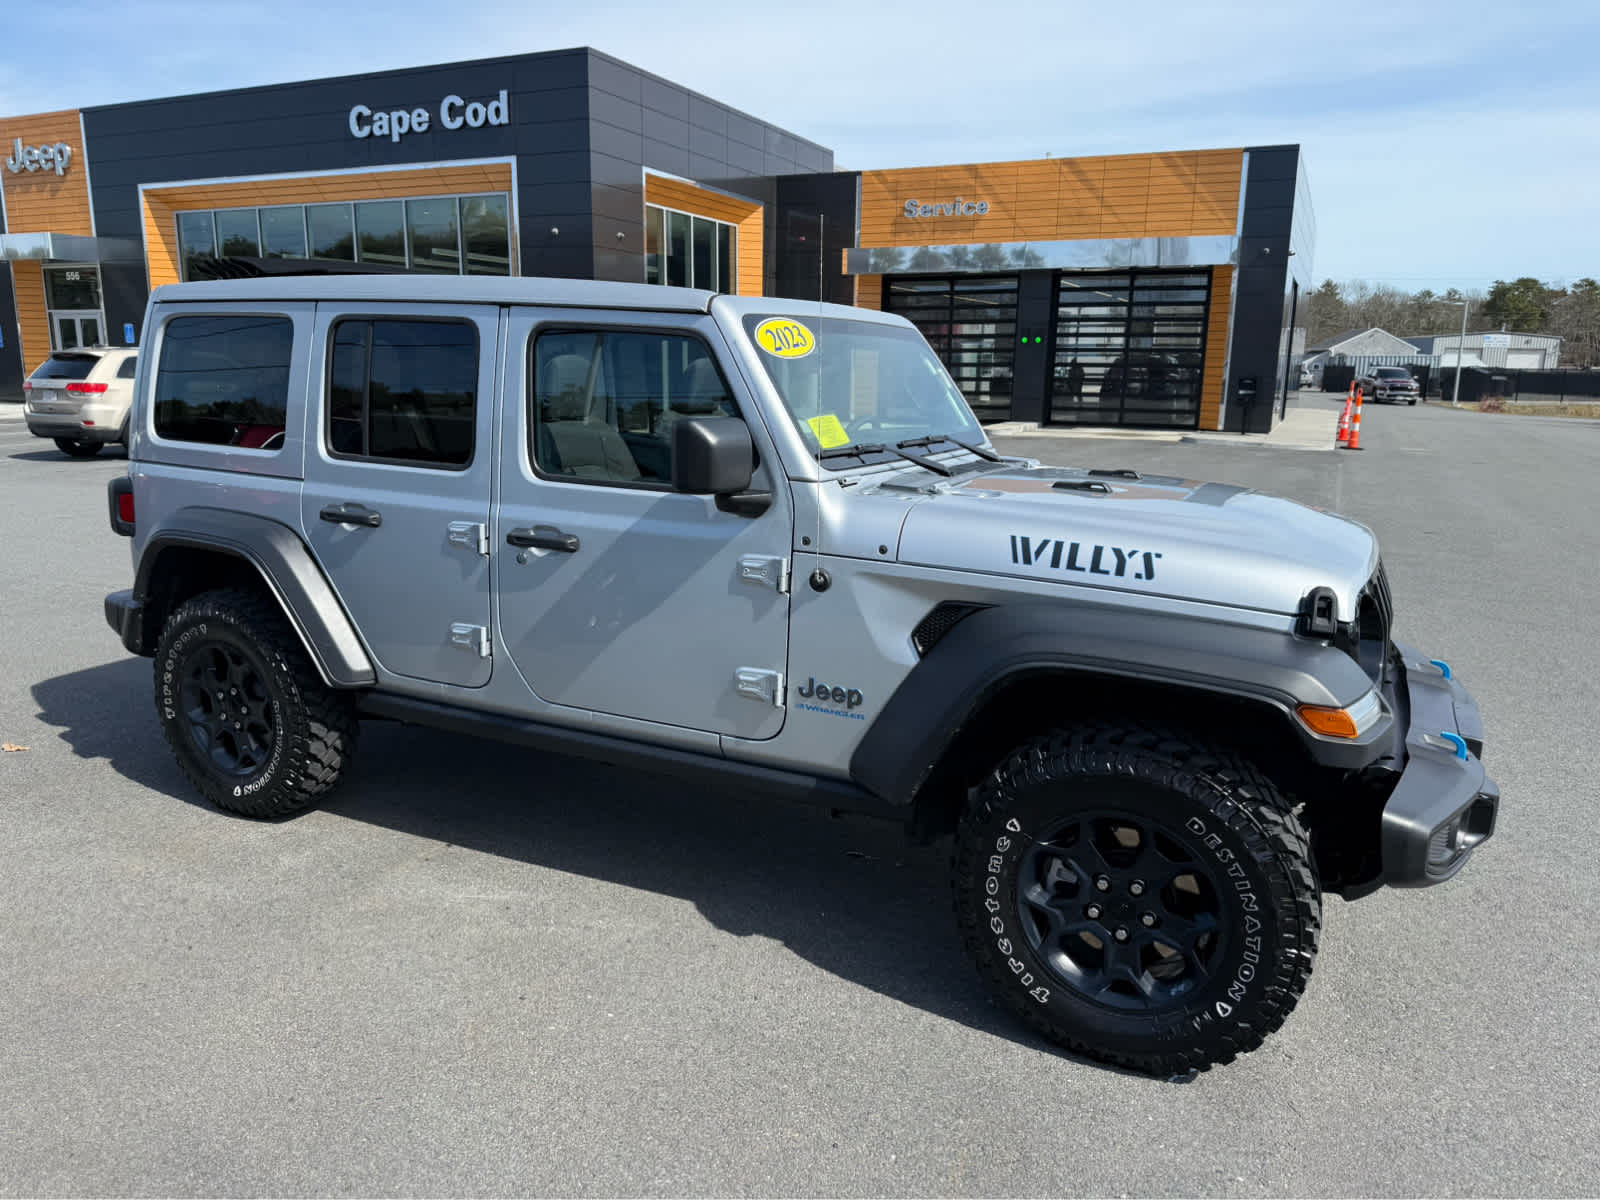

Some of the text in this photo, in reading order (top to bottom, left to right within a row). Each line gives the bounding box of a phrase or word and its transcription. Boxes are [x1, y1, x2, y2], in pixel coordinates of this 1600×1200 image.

[349, 89, 510, 142] Cape Cod
[6, 137, 73, 176] Jeep
[904, 197, 990, 218] Service
[765, 325, 808, 352] 2023
[1010, 535, 1162, 581] WILLYS
[798, 677, 863, 709] Jeep
[1185, 817, 1261, 1002] DESTINATION
